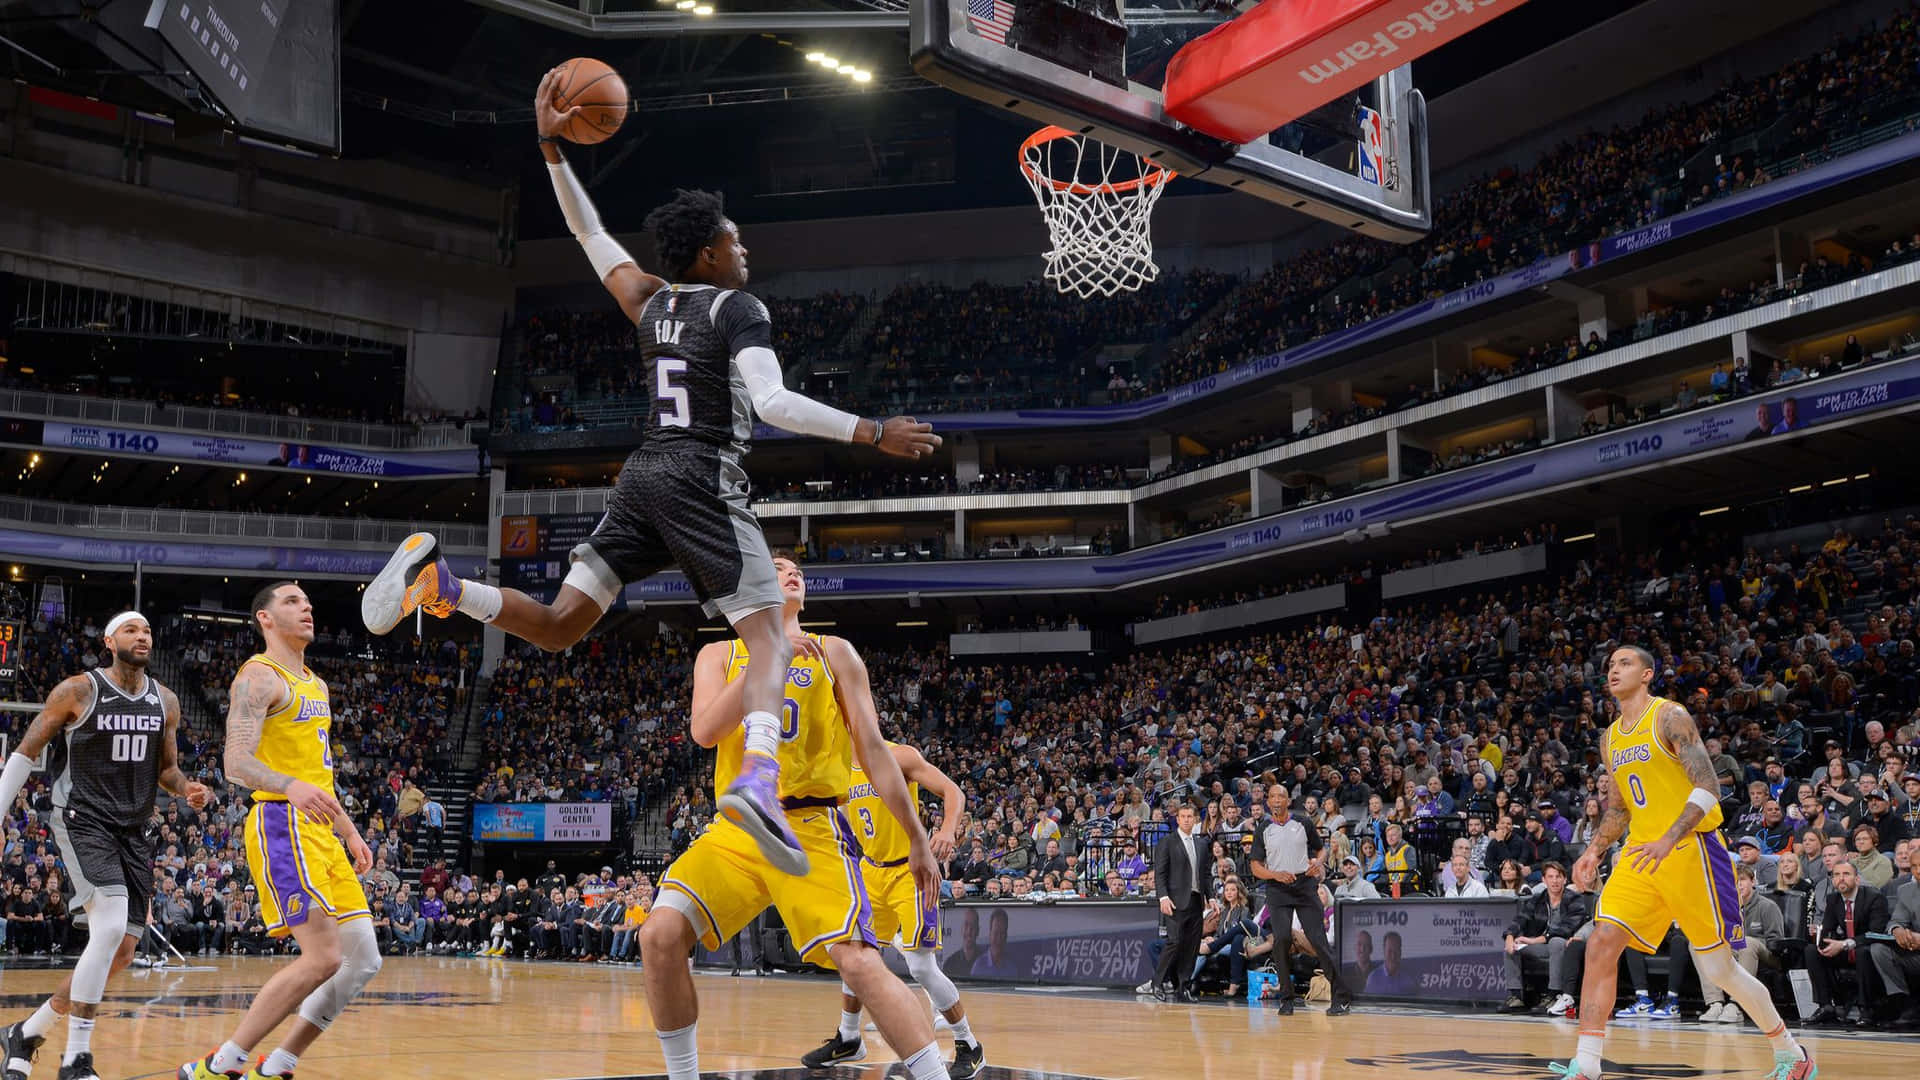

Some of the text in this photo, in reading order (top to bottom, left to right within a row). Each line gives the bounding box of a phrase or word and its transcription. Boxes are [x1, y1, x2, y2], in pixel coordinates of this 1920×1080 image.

[206, 5, 240, 52] TIMEOUTS
[1464, 280, 1495, 303] 1140
[655, 319, 685, 344] FOX
[656, 357, 691, 428] 5
[1816, 393, 1841, 409] 3PM
[1862, 383, 1888, 399] 7PM
[1831, 392, 1888, 413] WEEKDAYS
[107, 431, 158, 452] 1140
[1624, 435, 1663, 457] 1140
[315, 453, 385, 469] 3PM TO 7PM
[329, 463, 385, 475] WEEKDAYS
[1324, 508, 1355, 528] 1140
[1253, 525, 1281, 544] 1140
[292, 694, 330, 722] LAKE
[97, 714, 162, 732] KINGS
[111, 734, 148, 762] 00
[317, 727, 332, 767] 2
[1611, 743, 1651, 773] LAKERS
[1628, 773, 1647, 807] 0
[559, 806, 589, 814] GOLDEN
[562, 815, 593, 823] CENTER
[858, 806, 875, 838] 3
[553, 829, 568, 838] FEB
[572, 829, 581, 838] 14
[1376, 911, 1409, 926] 1140
[1432, 919, 1462, 927] GRANT
[1453, 928, 1480, 936] SHOW
[1056, 939, 1144, 958] WEEKDAYS
[1031, 954, 1141, 979] 3PM TO 7PM
[1440, 962, 1505, 978] WEEKDAY
[1420, 973, 1451, 988] 3PM
[1456, 976, 1473, 988] TO
